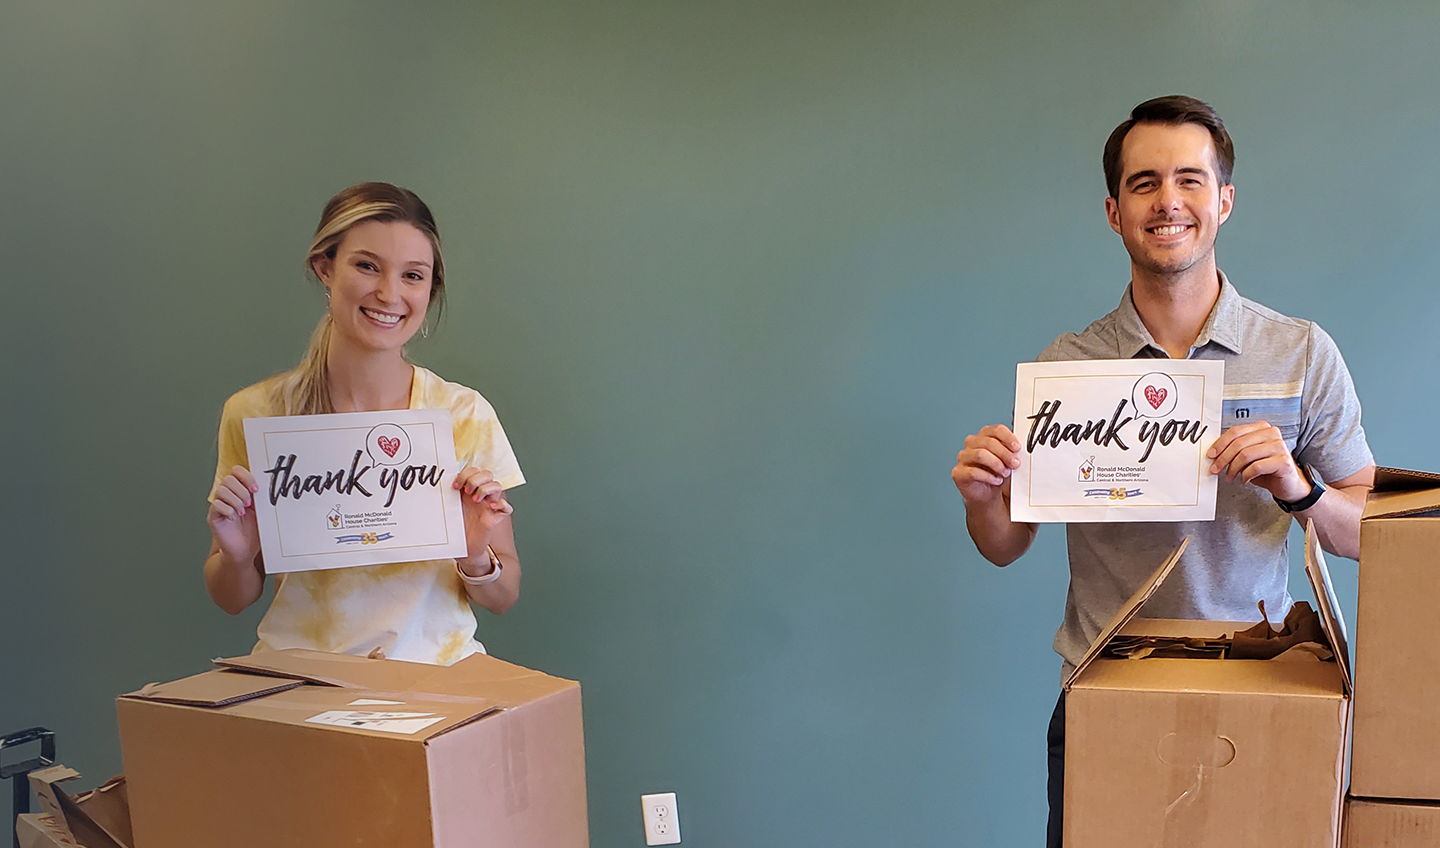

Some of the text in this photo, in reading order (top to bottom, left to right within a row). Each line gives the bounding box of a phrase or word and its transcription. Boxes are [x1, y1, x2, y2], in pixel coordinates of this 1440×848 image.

[1026, 398, 1208, 463] thank you
[263, 449, 445, 508] thank you
[1109, 487, 1127, 500] 35
[360, 532, 378, 545] 35
